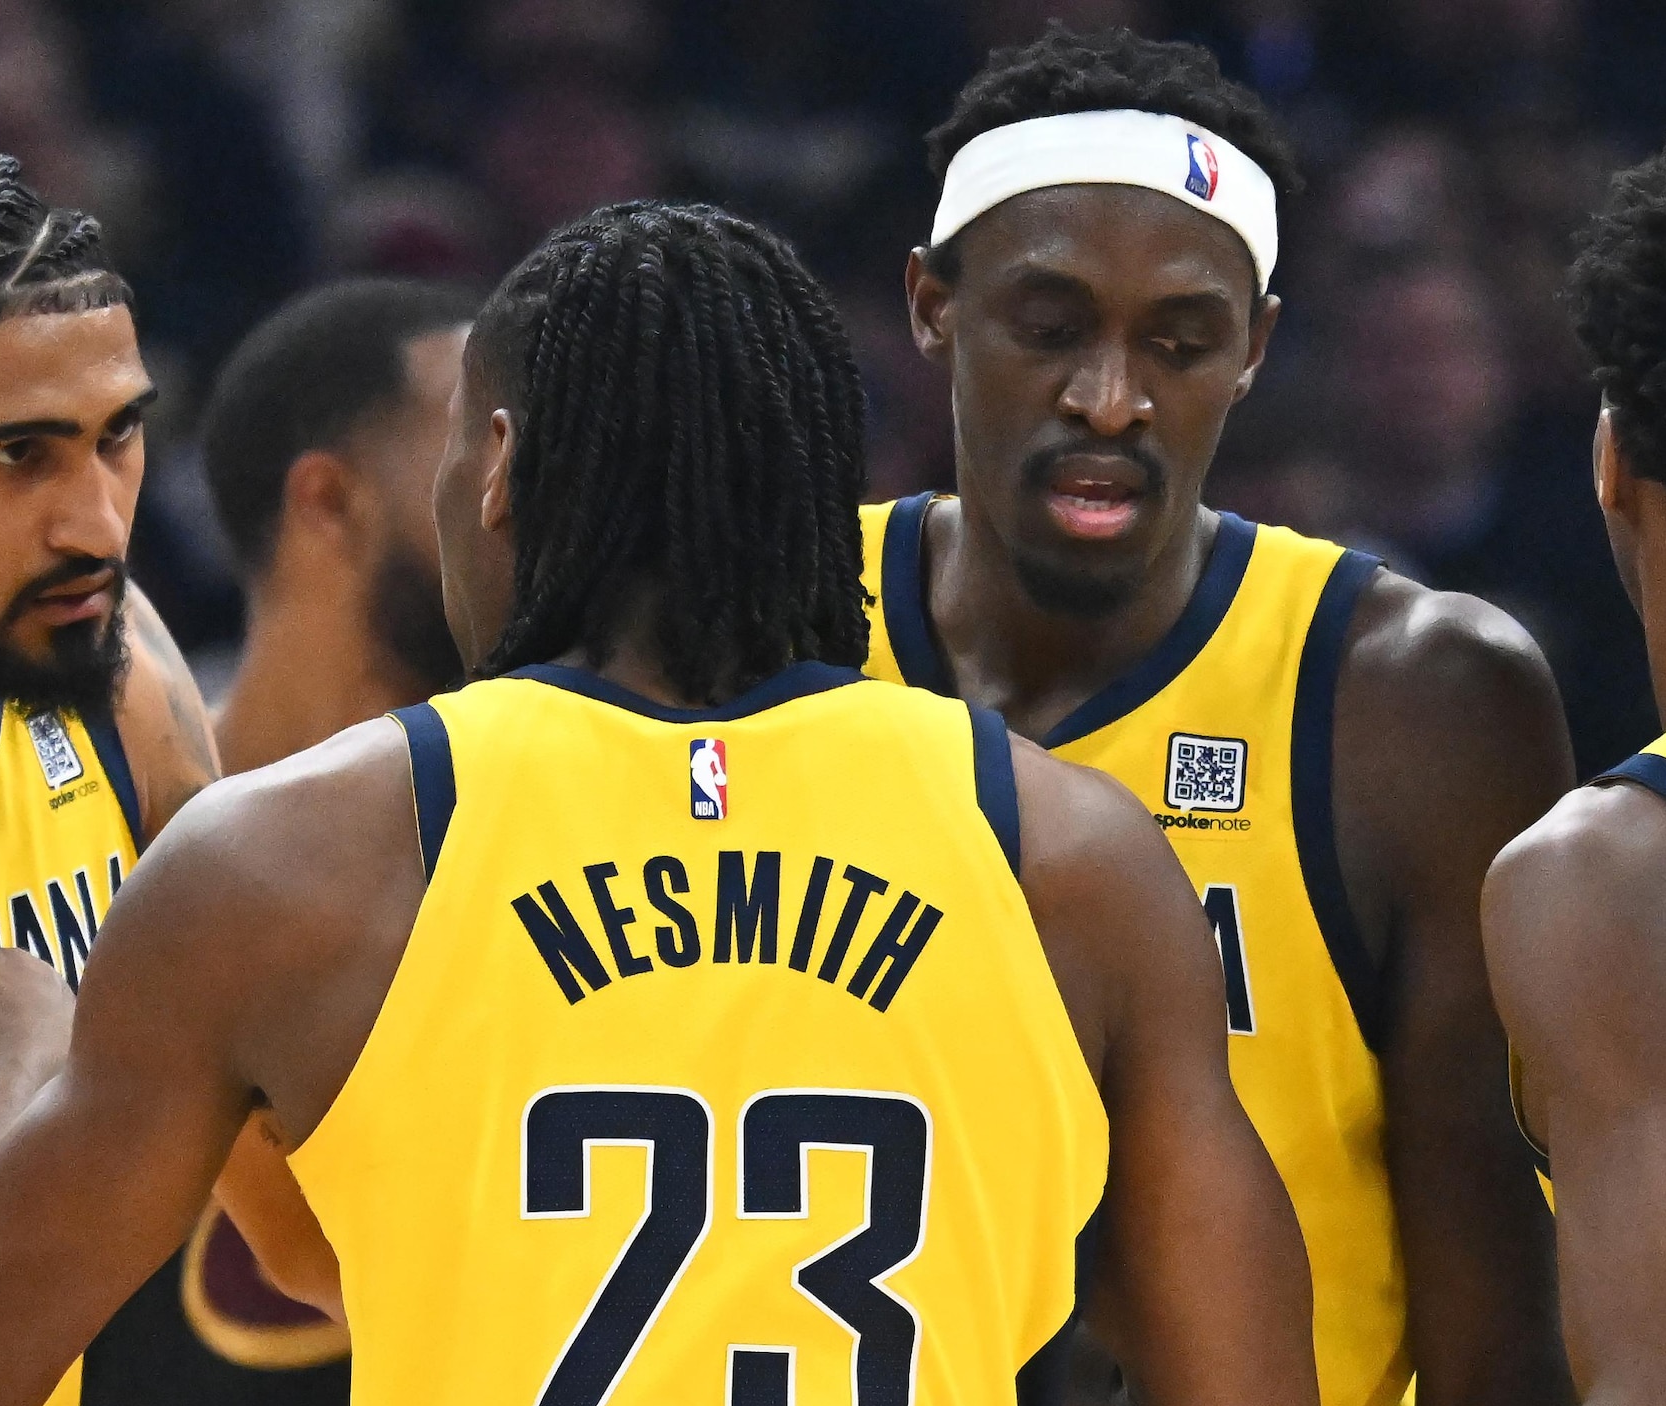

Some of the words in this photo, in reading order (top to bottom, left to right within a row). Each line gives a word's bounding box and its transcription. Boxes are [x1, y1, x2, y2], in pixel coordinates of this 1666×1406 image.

[694, 801, 715, 817] NBA
[1153, 812, 1252, 832] spokenote
[510, 850, 944, 1014] NESMITH
